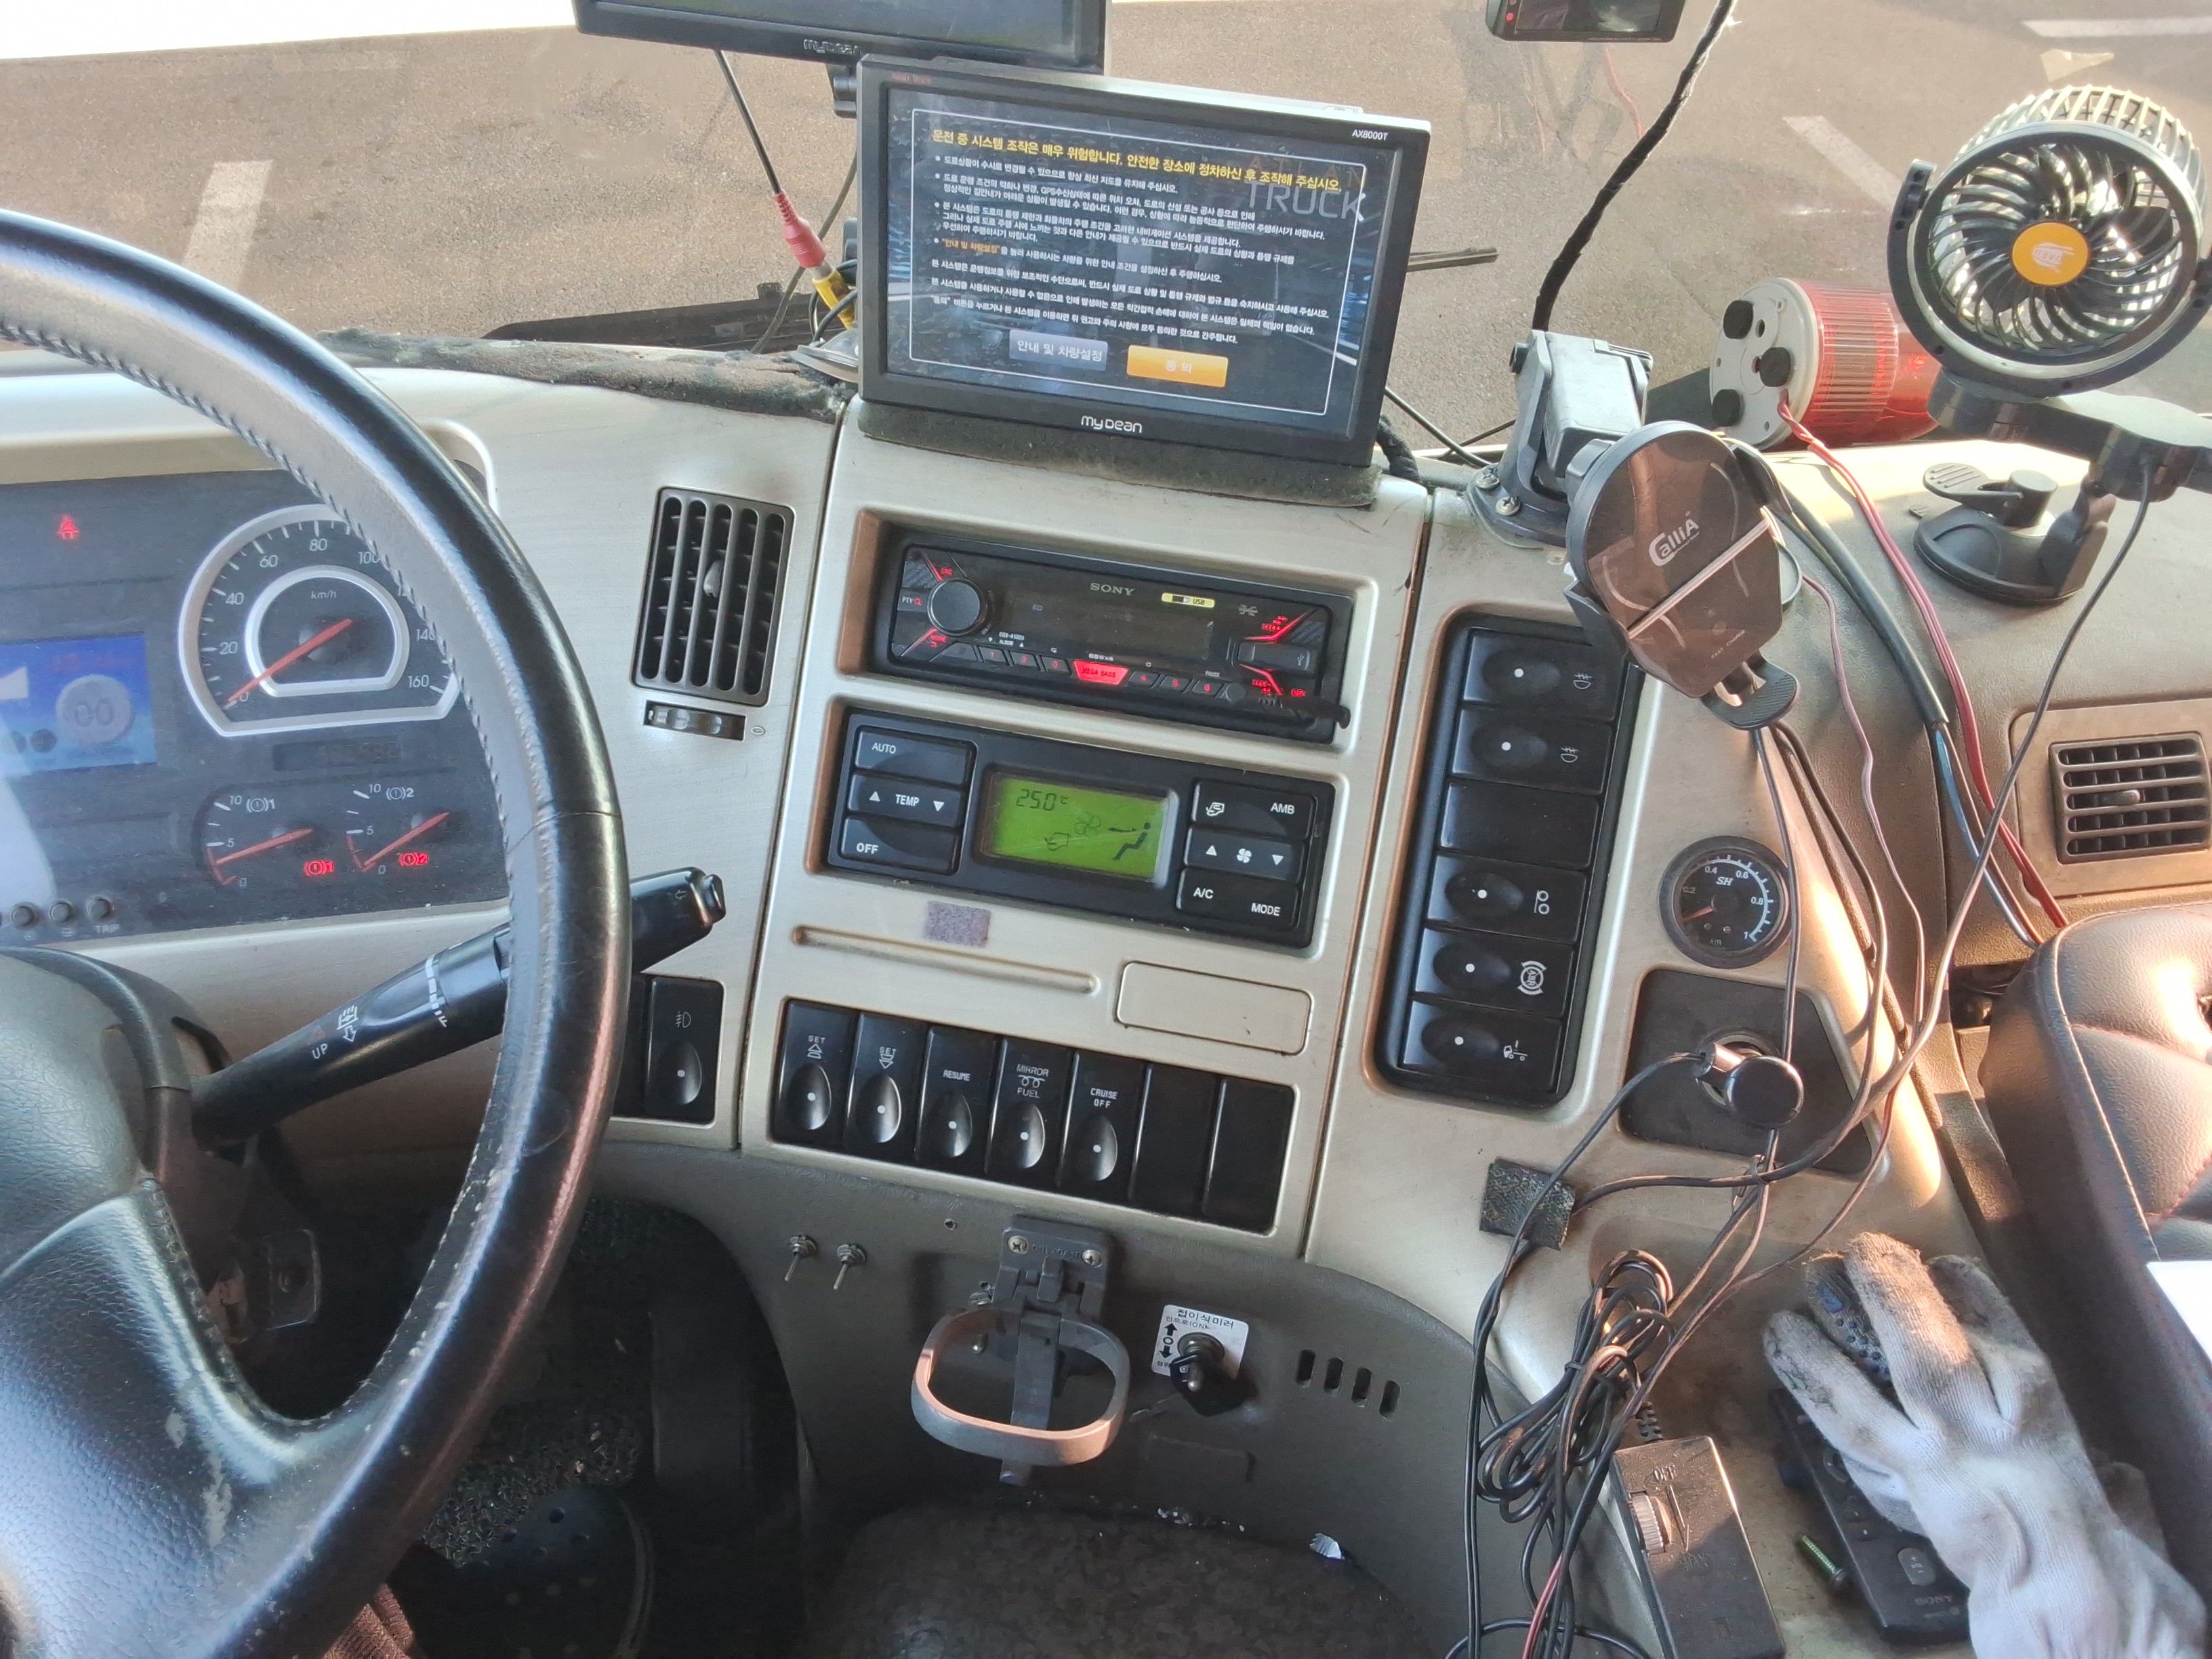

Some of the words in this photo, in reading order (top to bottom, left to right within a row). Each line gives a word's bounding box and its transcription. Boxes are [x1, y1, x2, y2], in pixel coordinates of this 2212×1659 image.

[1352, 129, 1389, 140] AX8000T
[933, 129, 954, 145] 운전
[957, 132, 968, 146] 중
[971, 134, 1003, 151] 시스템
[1007, 138, 1038, 155] 조작은
[1042, 142, 1063, 159] 매우
[1067, 146, 1123, 165] 위험합니다.
[1126, 153, 1160, 170] 안전한
[1162, 157, 1195, 174] 장소에
[1197, 161, 1242, 180] 정차하신
[1244, 167, 1257, 182] 후
[1259, 169, 1292, 186] 조작해
[1294, 173, 1343, 192] 주십시오.
[1244, 180, 1366, 222] TRUCK
[1018, 340, 1039, 352] 안내
[1044, 344, 1054, 356] 및
[1058, 345, 1102, 362] 차량설정
[309, 539, 327, 552] 80
[260, 555, 279, 568] 60
[310, 590, 337, 600] km/h
[1090, 583, 1135, 596] SONY
[225, 592, 244, 605] 40
[1193, 598, 1205, 606] USB
[220, 642, 237, 655] 20
[407, 674, 430, 688] 160
[872, 742, 897, 754] AUTO
[369, 783, 381, 794] 10
[230, 795, 242, 805] 10
[896, 794, 920, 806] TEMP
[1270, 802, 1294, 815] AMB
[857, 842, 878, 855] OFF
[1704, 865, 1717, 874] 0.4
[1736, 871, 1748, 879] 0.6
[1193, 887, 1214, 899] A/C
[1750, 897, 1763, 905] 0.8
[1252, 903, 1281, 916] MODE
[95, 924, 120, 933] TRIP
[808, 1035, 826, 1044] SET
[312, 1043, 328, 1059] UP
[879, 1046, 897, 1057] SET
[943, 1069, 970, 1082] RESUME
[1017, 1064, 1049, 1078] MIRROR
[1017, 1088, 1040, 1099] FUEL
[1090, 1088, 1118, 1100] CRUISE
[1093, 1099, 1111, 1108] OFF
[1177, 1309, 1234, 1329] 접이식미러
